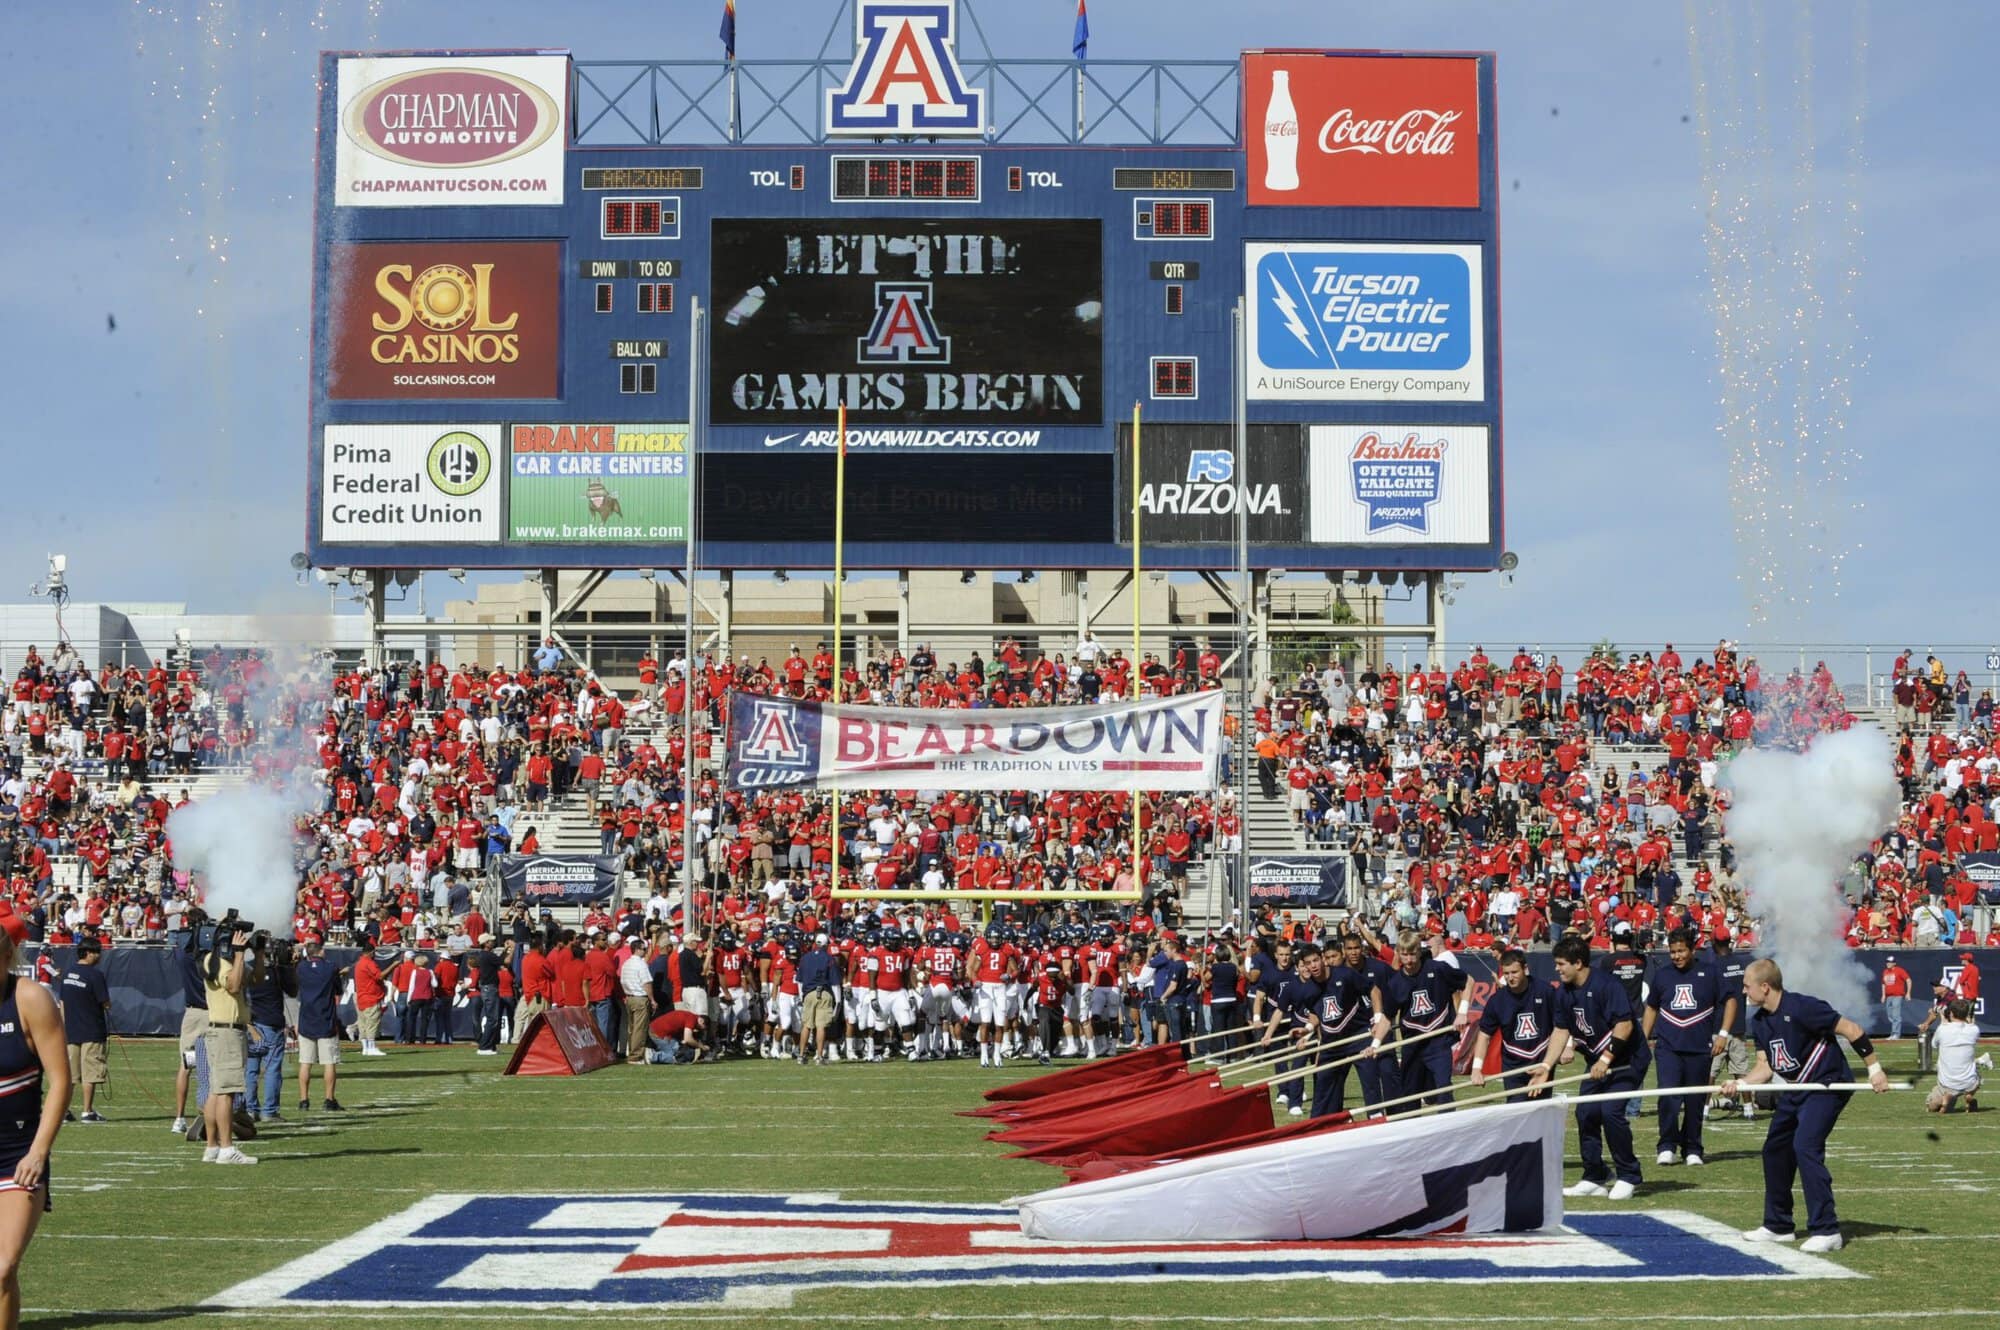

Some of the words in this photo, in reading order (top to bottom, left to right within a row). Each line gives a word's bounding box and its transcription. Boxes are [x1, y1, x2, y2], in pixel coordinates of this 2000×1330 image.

[826, 0, 984, 134] A
[380, 93, 520, 129] CHAPMAN
[383, 131, 517, 145] AUTOMOTIVE
[1318, 108, 1463, 155] Coca-Cola
[351, 179, 547, 192] CHAPMANTUCSON.COM
[603, 169, 683, 188] ARIZONA
[750, 171, 785, 187] TOL
[1028, 172, 1062, 187] TOL
[1153, 171, 1191, 189] WSU
[592, 262, 616, 278] DWN
[640, 262, 653, 278] TO
[656, 262, 672, 278] GO
[1164, 264, 1185, 278] QTR
[1312, 266, 1419, 296] Tucson
[371, 263, 519, 332] SOL
[1322, 296, 1450, 324] Electric
[1336, 325, 1450, 352] Power
[371, 334, 519, 364] CASINOS
[617, 342, 642, 357] BALL
[645, 342, 661, 357] ON
[393, 374, 496, 385] SOLCASINOS.COM
[1257, 377, 1268, 389] A
[1272, 377, 1346, 390] UniSource
[1350, 378, 1399, 394] Energy
[1403, 378, 1470, 394] Company
[732, 373, 904, 411] GAMES
[923, 374, 1083, 411] BEGIN
[800, 430, 1040, 447] ARIZONAWILDCATS.COM
[333, 445, 391, 463] Pima
[1353, 436, 1445, 459] Bashas'
[516, 457, 551, 474] CAR
[558, 457, 601, 474] CARE
[609, 457, 684, 474] CENTERS
[1187, 450, 1235, 482] FS
[1359, 465, 1434, 476] OFFICIAL
[333, 474, 420, 494] Federal
[1359, 478, 1434, 489] TAILGATE
[1132, 484, 1282, 514] ARIZONA
[1360, 490, 1434, 498] HEADQUARTERS
[332, 505, 404, 523] Credit
[412, 505, 482, 523] Union
[1373, 507, 1422, 517] ARIZONA
[516, 525, 683, 538] www.brakemax.com
[1987, 656, 2000, 669] 30
[941, 760, 967, 771] THE
[973, 760, 1053, 771] TRADITION
[1058, 760, 1098, 771] LIVES
[526, 866, 565, 874] AMERICAN
[567, 866, 595, 874] FAMILY
[885, 955, 903, 972] 54
